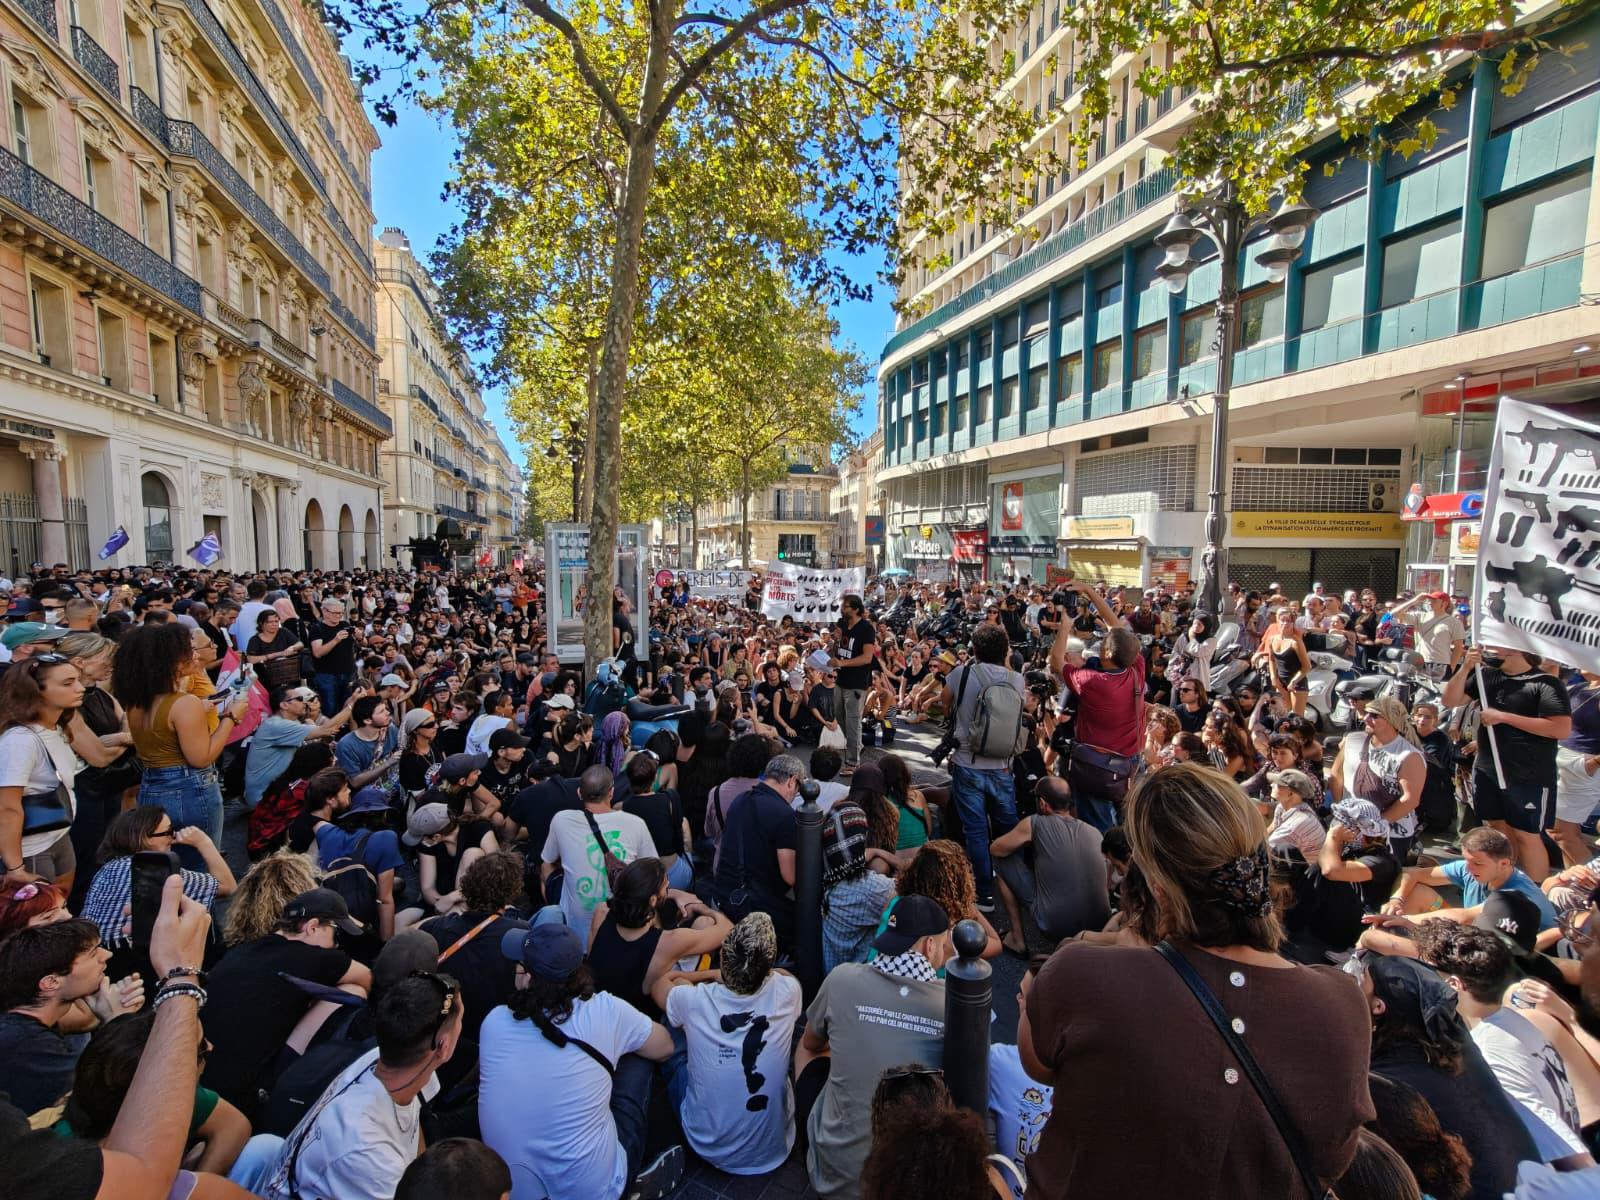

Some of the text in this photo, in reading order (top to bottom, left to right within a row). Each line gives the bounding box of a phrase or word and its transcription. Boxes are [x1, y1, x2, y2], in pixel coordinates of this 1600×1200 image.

[729, 571, 744, 588] DE
[768, 591, 796, 602] MORTS
[930, 1019, 945, 1028] LOUP
